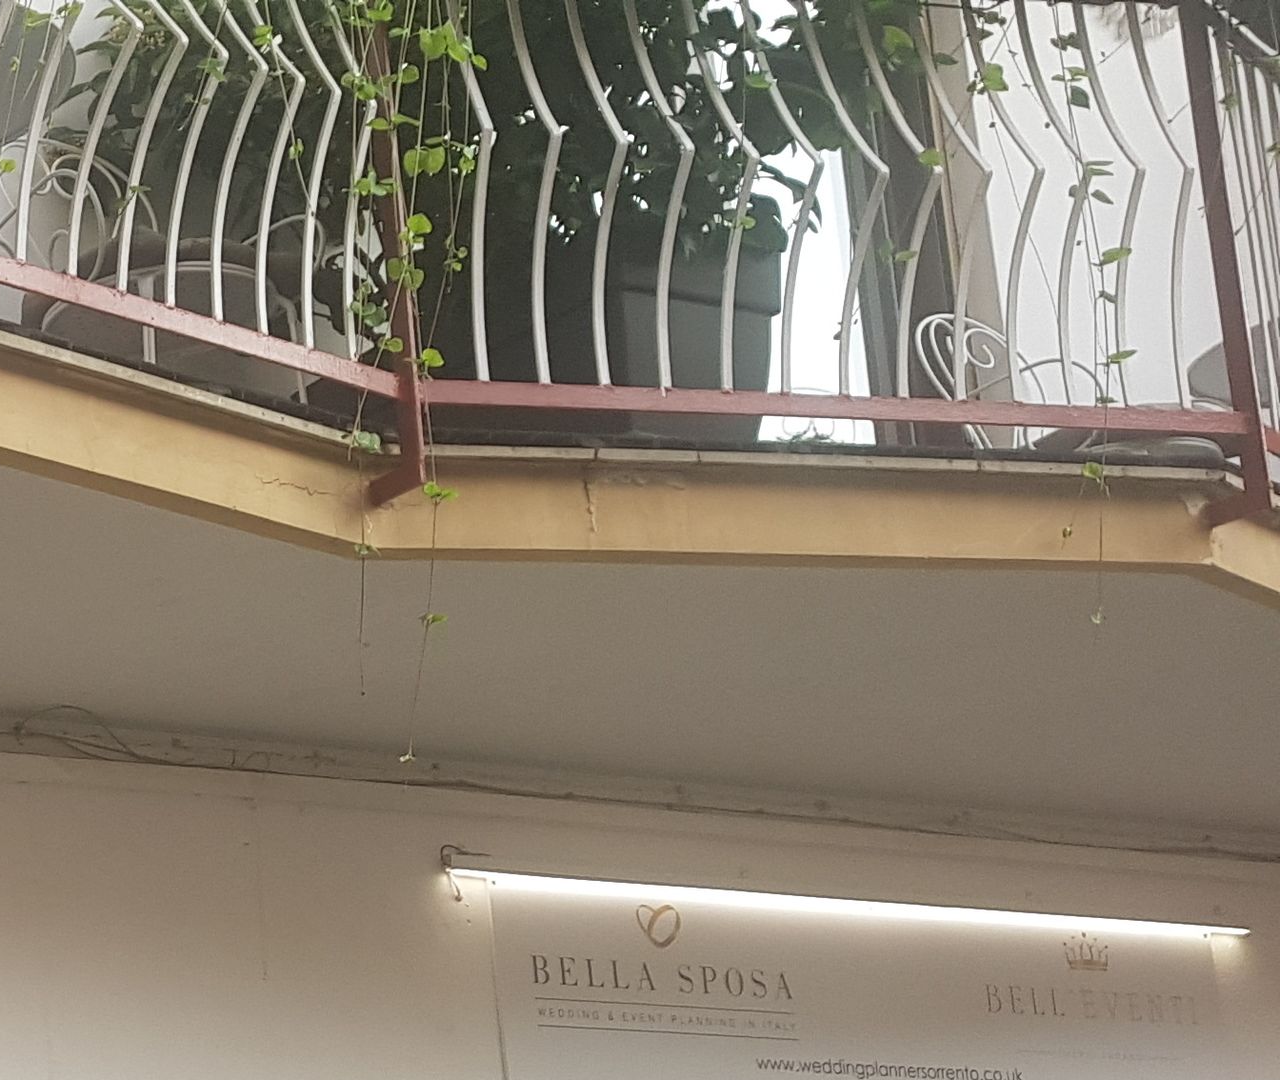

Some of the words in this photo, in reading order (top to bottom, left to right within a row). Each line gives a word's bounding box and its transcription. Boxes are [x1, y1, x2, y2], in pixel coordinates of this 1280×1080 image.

[531, 954, 657, 991] BELLA
[677, 964, 794, 1000] SPOSA
[538, 1007, 600, 1021] WEDDING
[607, 1011, 615, 1022] &
[621, 1011, 664, 1023] EVENT
[671, 1014, 736, 1028] PLANNING
